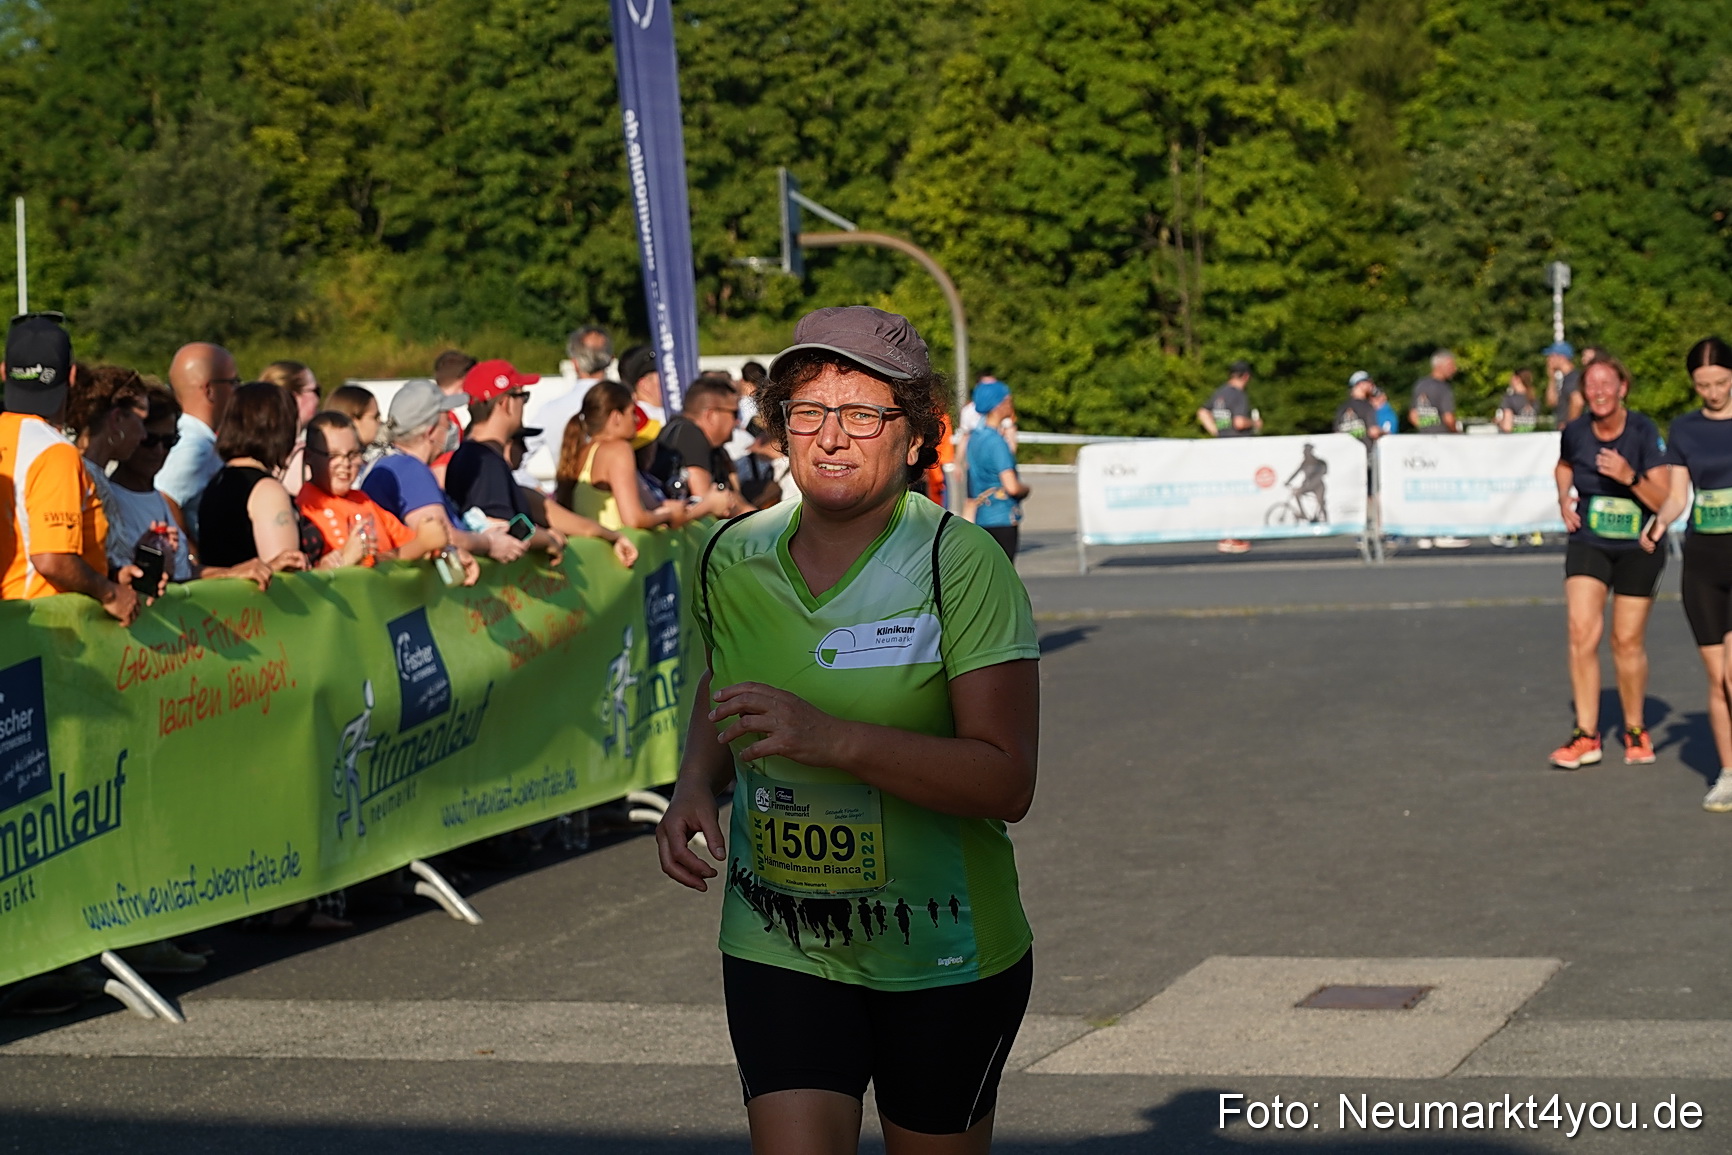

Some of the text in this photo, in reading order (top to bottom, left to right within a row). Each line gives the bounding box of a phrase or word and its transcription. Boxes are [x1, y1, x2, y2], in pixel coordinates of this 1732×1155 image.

[116, 616, 204, 692] Gesunde
[876, 625, 915, 636] Klinikum
[159, 676, 223, 738] laufen
[770, 802, 810, 812] Firmenlauf
[754, 817, 765, 871] WALK
[764, 817, 856, 862] 1509
[764, 854, 861, 874] Hämmelmann Bianca
[861, 831, 877, 881] 2022
[82, 841, 302, 931] www.firmenlauf-oberpfalz.de
